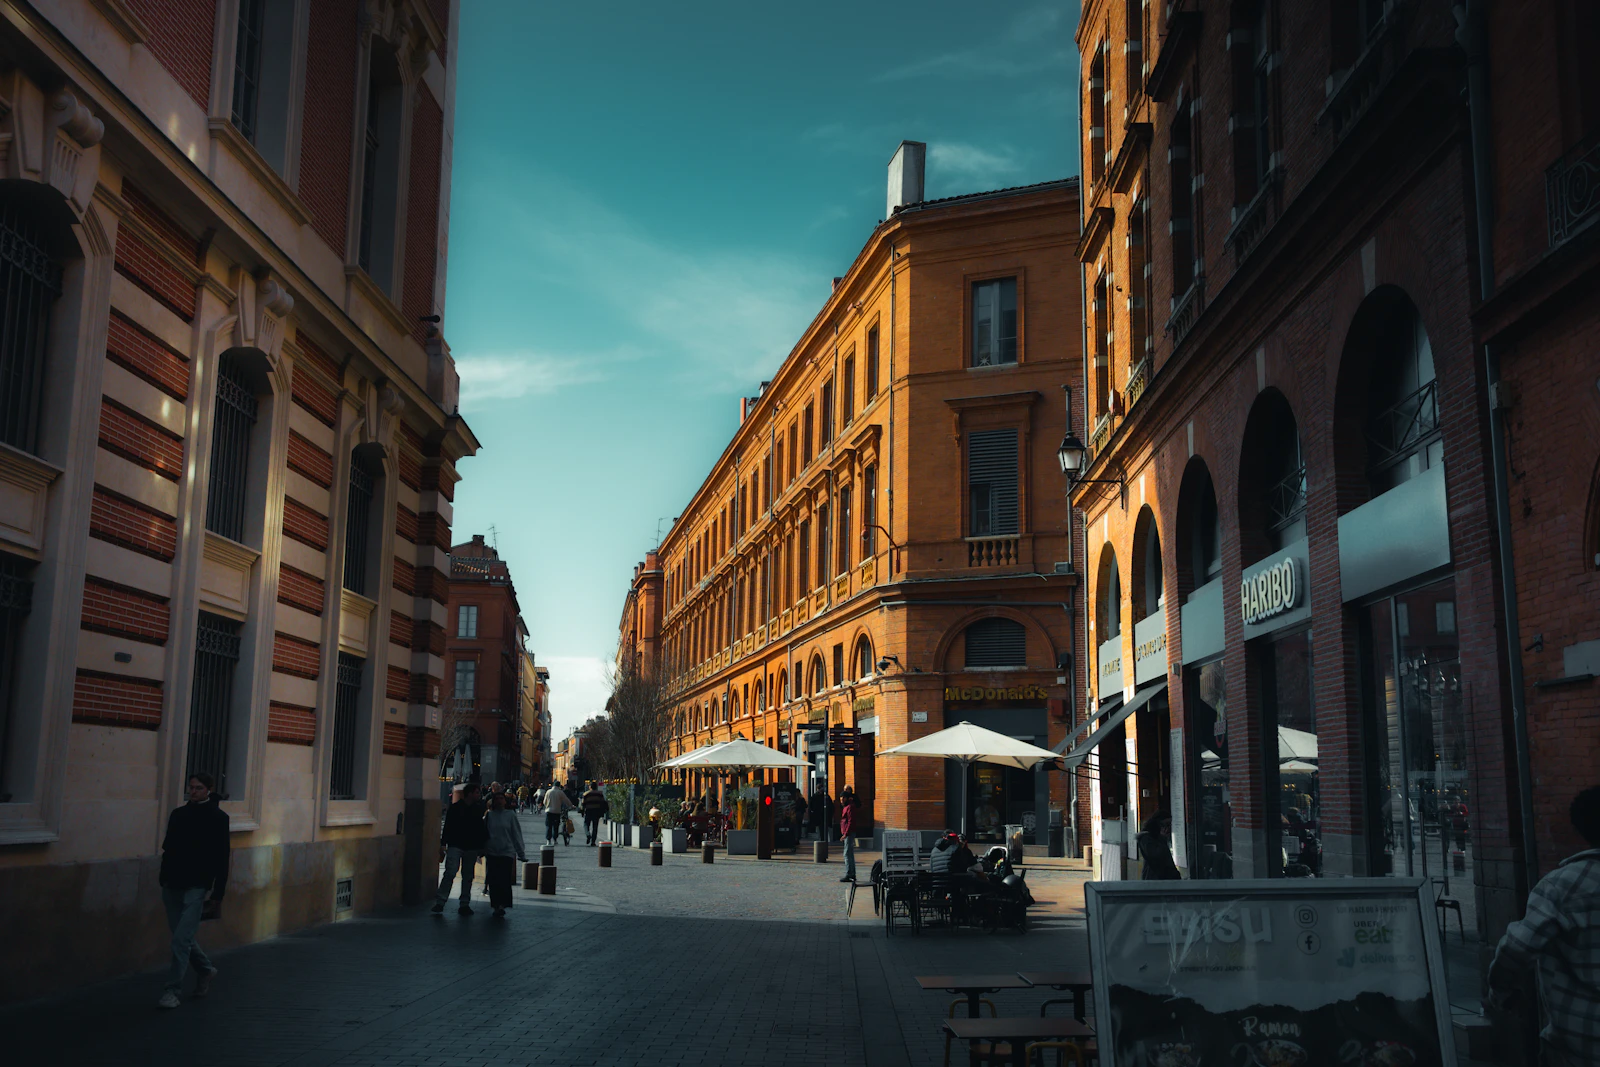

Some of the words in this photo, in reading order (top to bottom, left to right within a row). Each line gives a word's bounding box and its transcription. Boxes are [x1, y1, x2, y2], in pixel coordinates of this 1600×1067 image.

[1241, 557, 1295, 625] HARIBO
[944, 684, 1048, 701] McDonald's
[1241, 1016, 1301, 1037] Ramen
